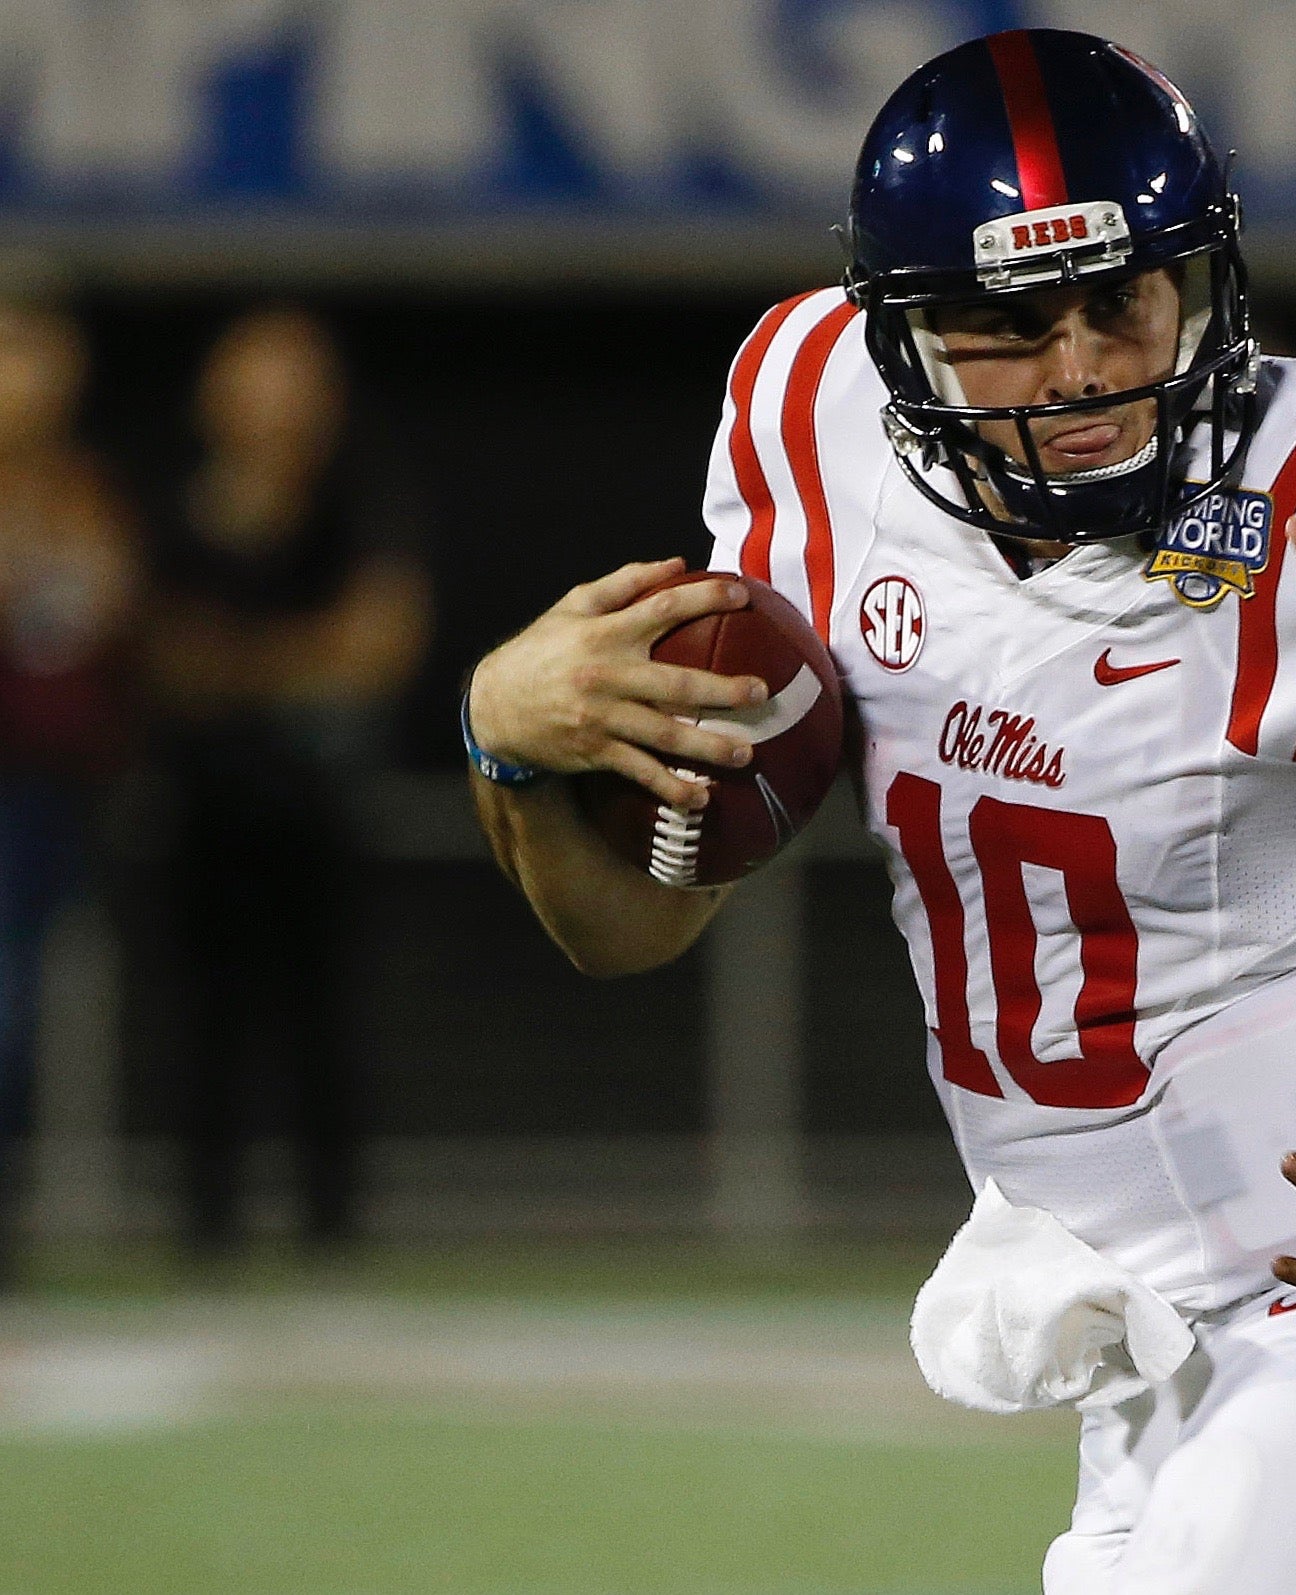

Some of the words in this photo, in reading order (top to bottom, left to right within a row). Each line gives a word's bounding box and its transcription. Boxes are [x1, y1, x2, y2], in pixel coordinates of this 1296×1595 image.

[1011, 214, 1088, 250] REBS
[1182, 494, 1265, 528] MPING
[863, 580, 921, 664] SEC
[939, 700, 985, 769] Ole
[983, 710, 1066, 787] Miss
[886, 771, 1151, 1109] 10
